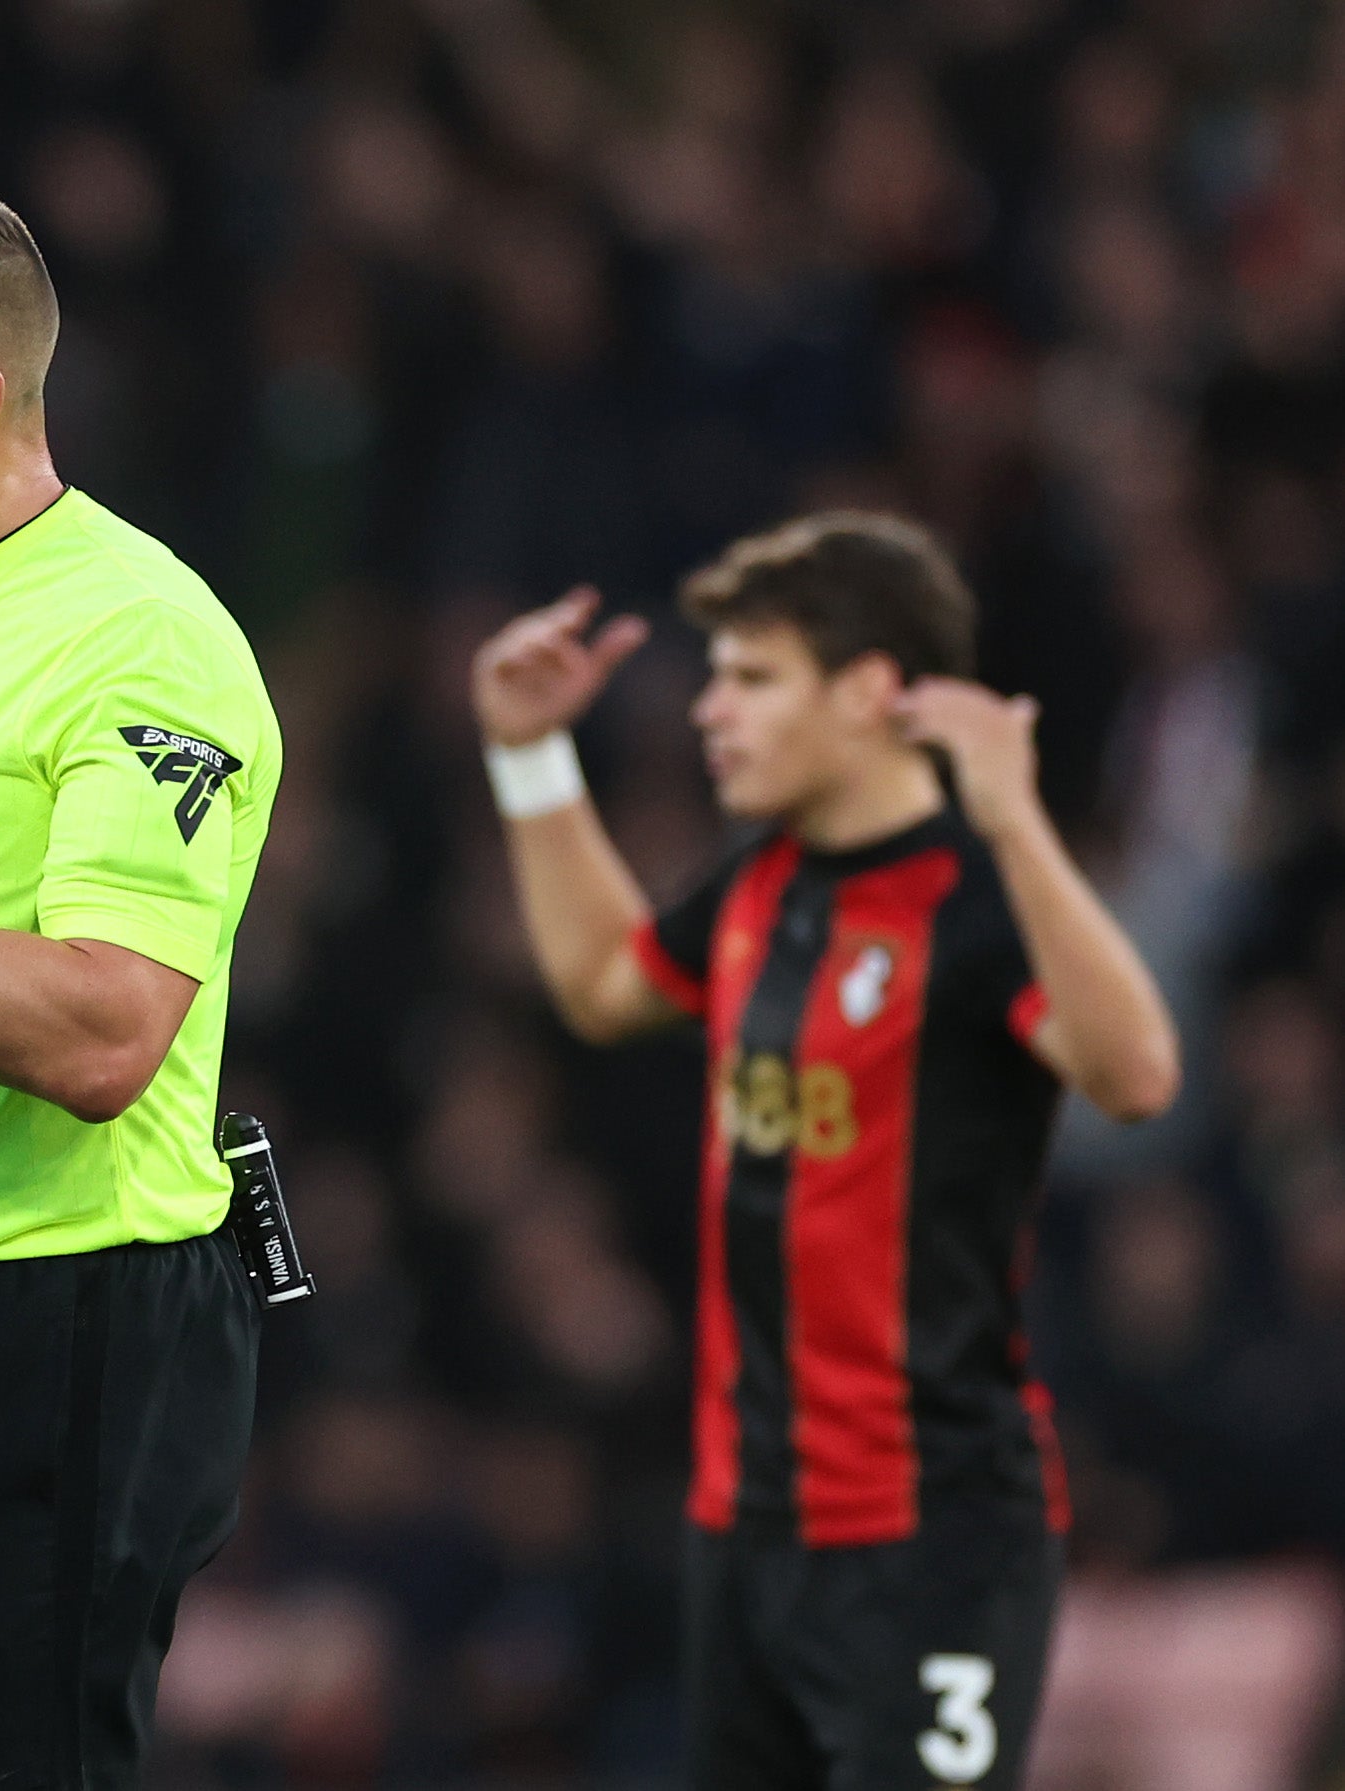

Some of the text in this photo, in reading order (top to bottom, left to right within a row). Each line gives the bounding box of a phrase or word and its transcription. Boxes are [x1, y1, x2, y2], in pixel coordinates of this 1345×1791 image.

[142, 727, 226, 769] EA SPORTS
[915, 1652, 999, 1785] 3
